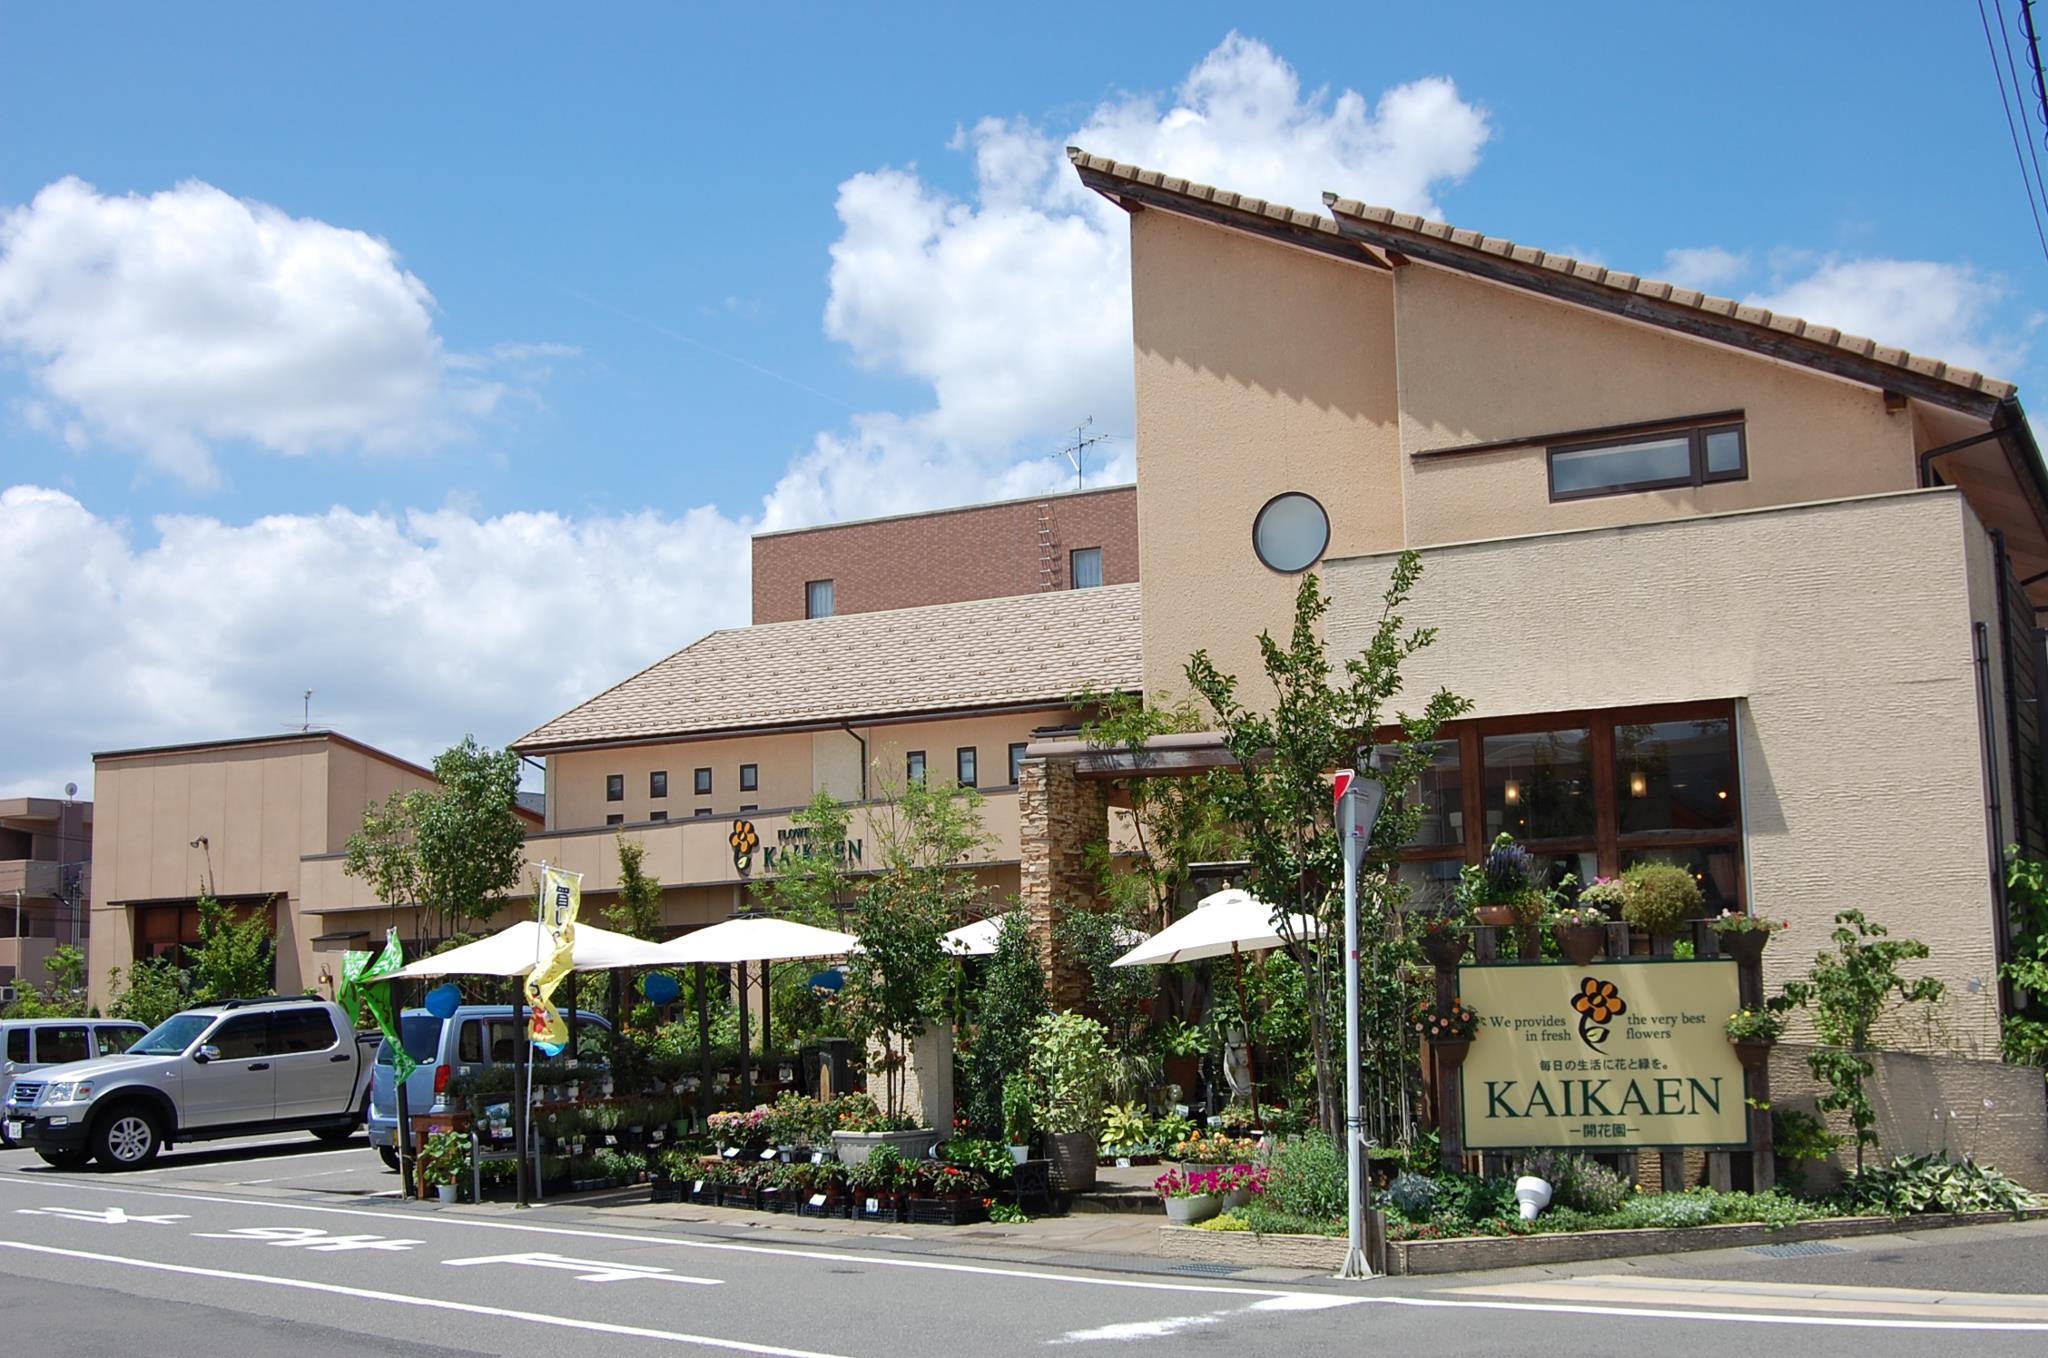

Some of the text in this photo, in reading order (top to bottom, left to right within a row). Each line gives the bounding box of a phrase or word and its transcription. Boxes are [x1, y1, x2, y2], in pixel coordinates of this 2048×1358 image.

[1490, 1015, 1566, 1030] We provides
[1627, 1013, 1706, 1028] the very best
[1525, 1028, 1572, 1042] in fresh
[1626, 1028, 1671, 1040] flowers
[1540, 1059, 1668, 1072] 毎日の生活に花と緑を。
[1484, 1077, 1723, 1118] KAIKAEN
